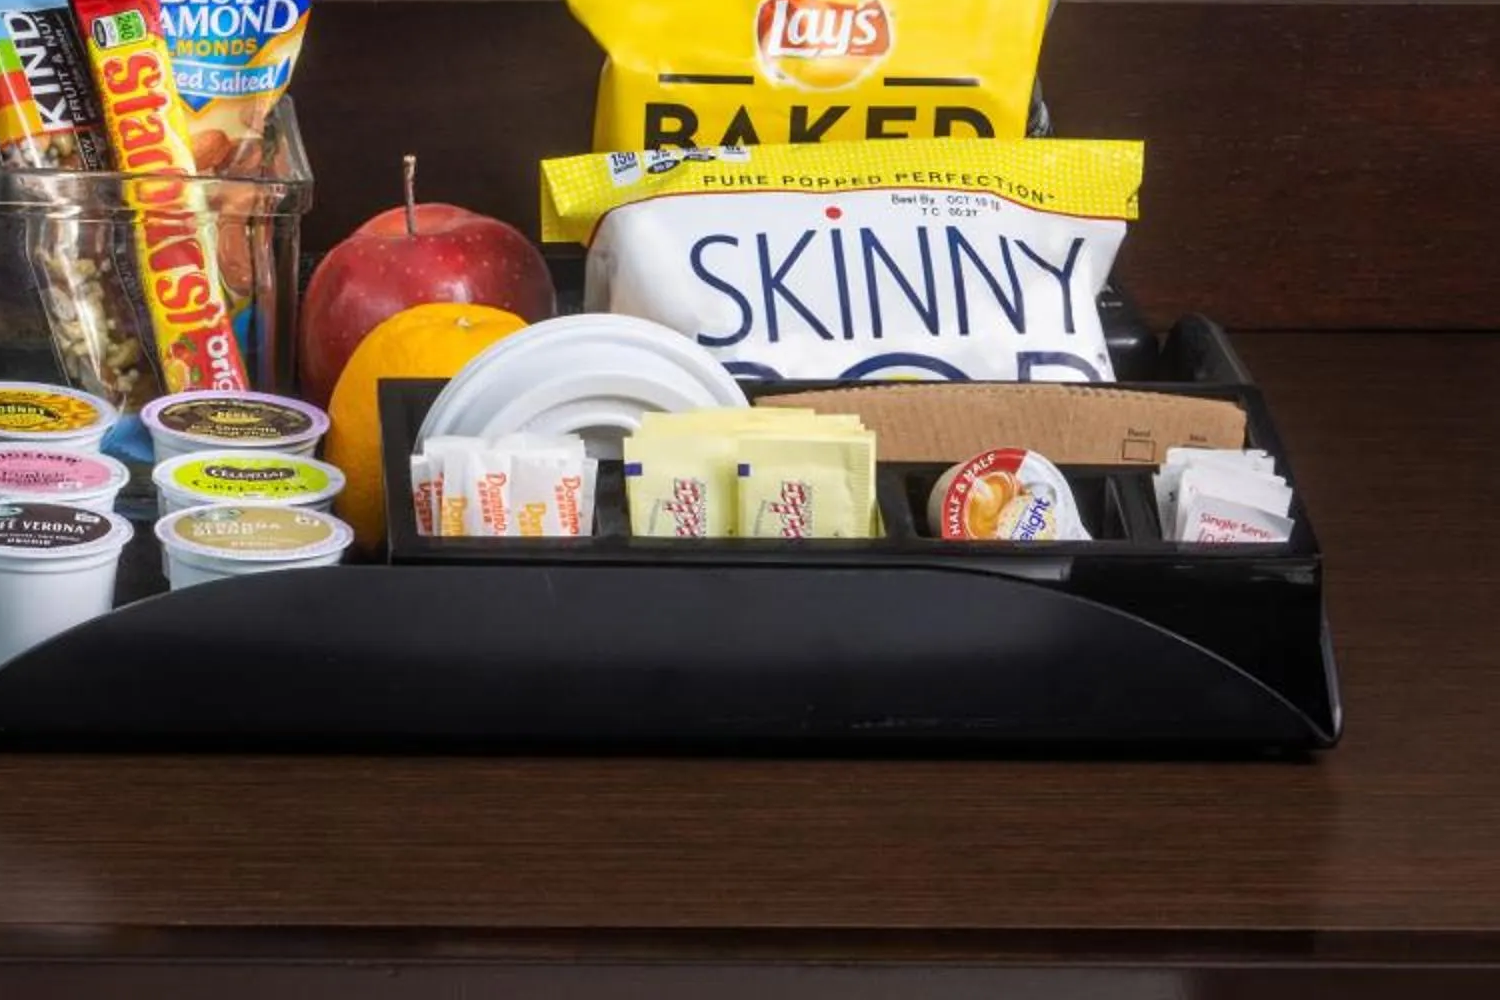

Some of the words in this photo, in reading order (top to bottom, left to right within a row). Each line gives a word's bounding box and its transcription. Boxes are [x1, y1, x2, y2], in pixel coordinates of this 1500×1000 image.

[167, 37, 258, 58] MONDS
[3, 10, 75, 132] KIND
[208, 64, 275, 93] Salted
[702, 174, 770, 187] PURE
[782, 175, 883, 188] POPPED
[1019, 497, 1051, 541] elight
